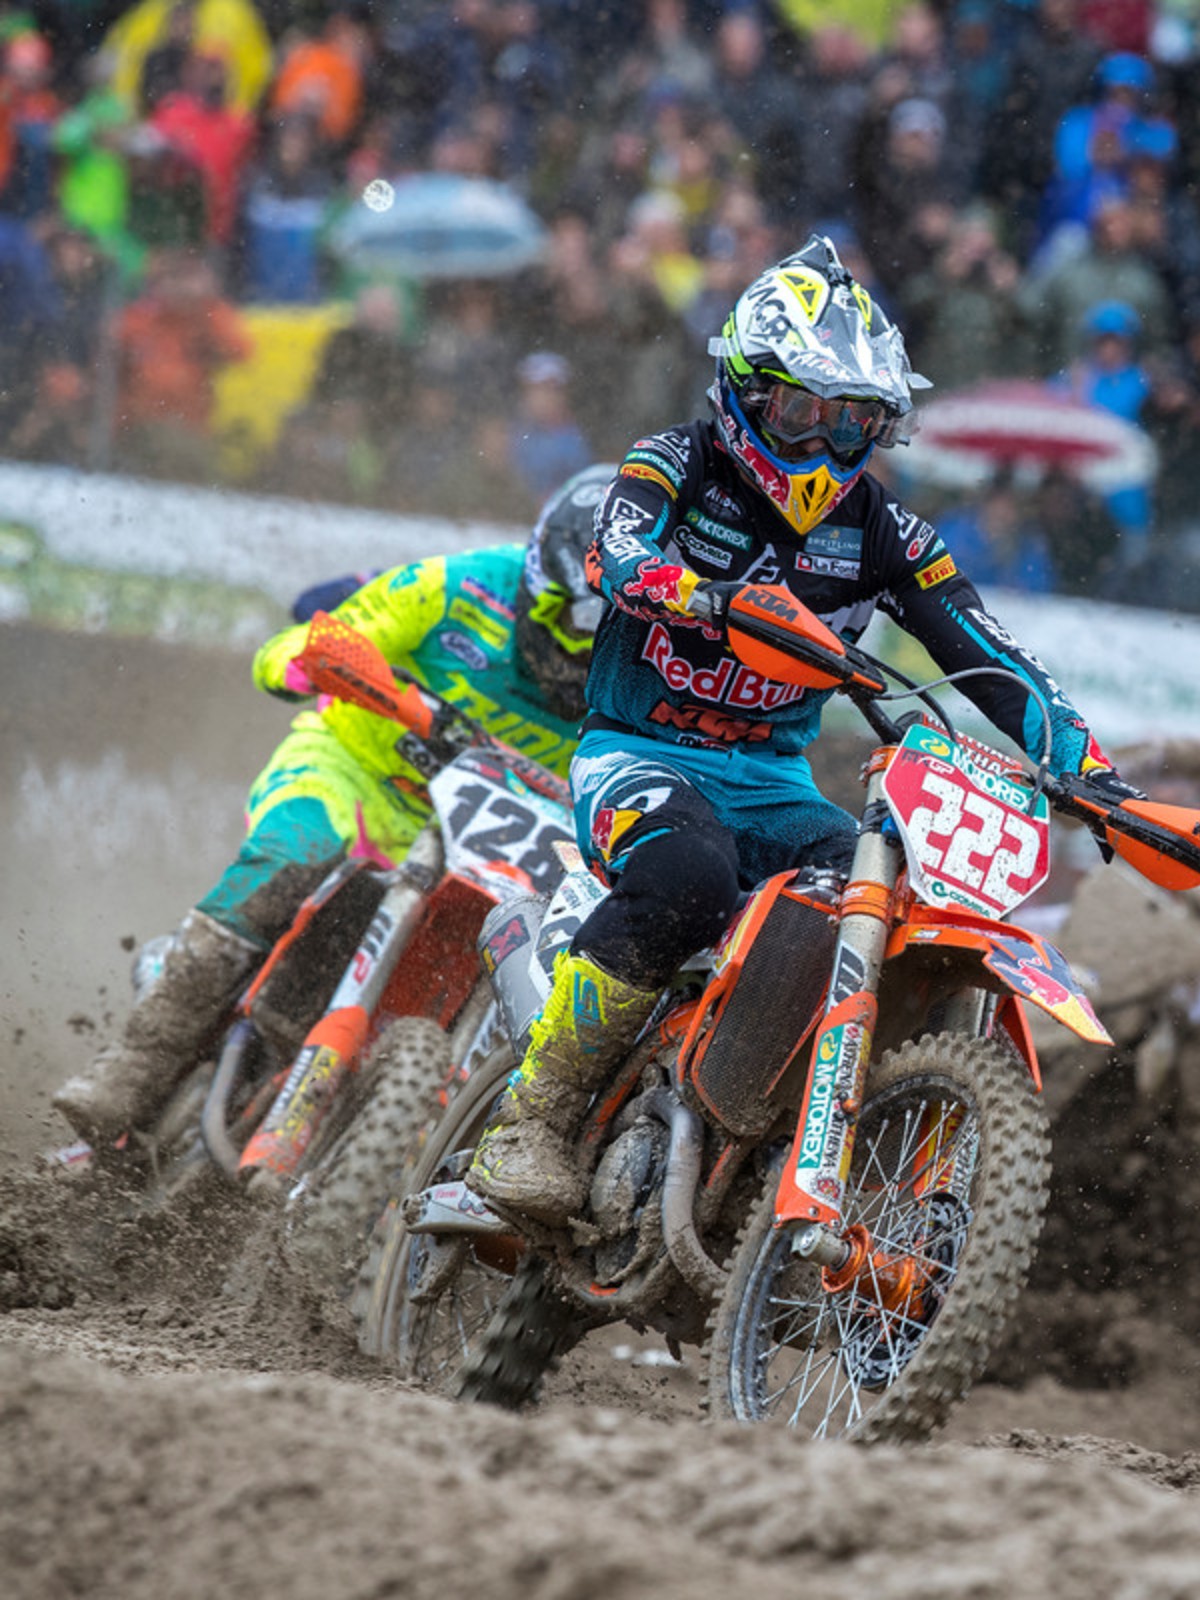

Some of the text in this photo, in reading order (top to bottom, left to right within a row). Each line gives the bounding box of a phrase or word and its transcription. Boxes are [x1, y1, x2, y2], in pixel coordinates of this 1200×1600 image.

[697, 516, 749, 549] MOTOREX
[806, 536, 861, 551] BREITLING
[742, 588, 799, 623] KTM
[641, 621, 736, 702] Red
[650, 700, 774, 743] KTM
[906, 770, 1041, 914] 222
[800, 1062, 835, 1167] MOTOREX
